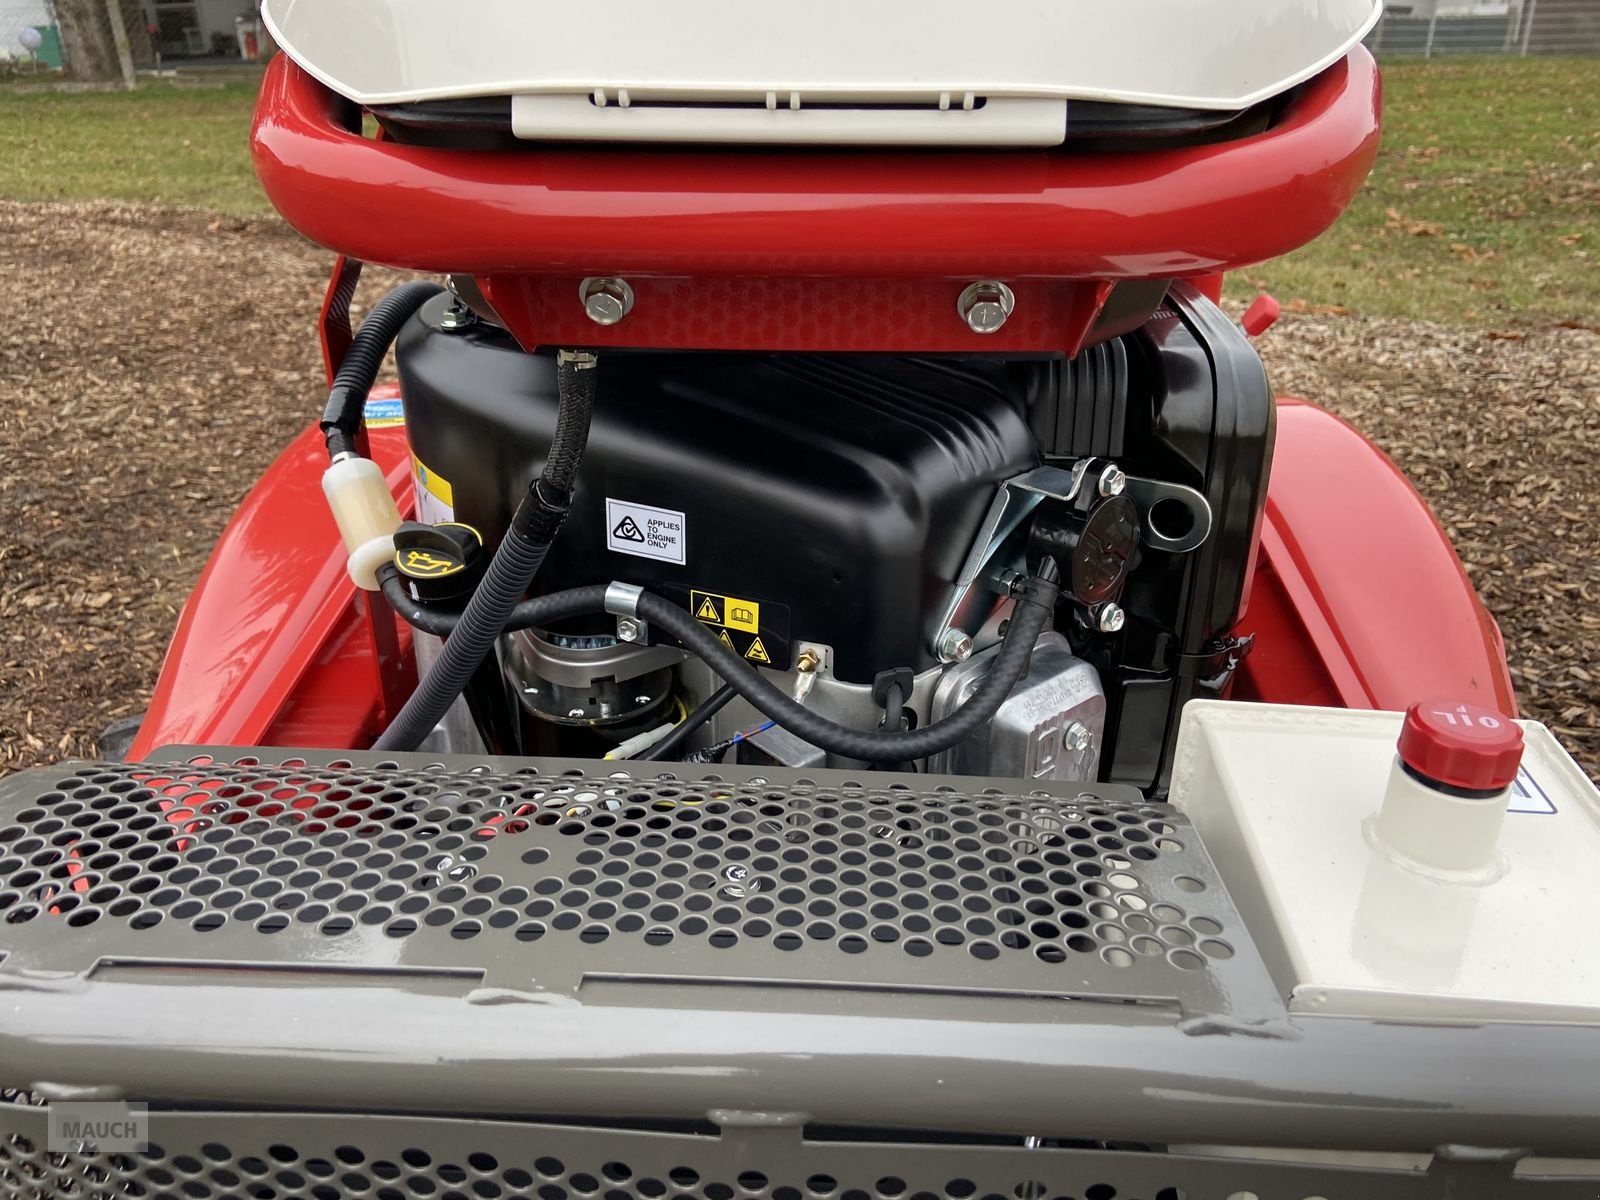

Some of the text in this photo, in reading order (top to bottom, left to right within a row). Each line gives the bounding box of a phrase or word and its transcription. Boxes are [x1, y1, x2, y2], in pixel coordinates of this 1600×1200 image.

[647, 518, 680, 531] APPLIES
[647, 533, 676, 544] ENGINE
[647, 540, 667, 549] ONLY
[1432, 711, 1500, 728] OIL
